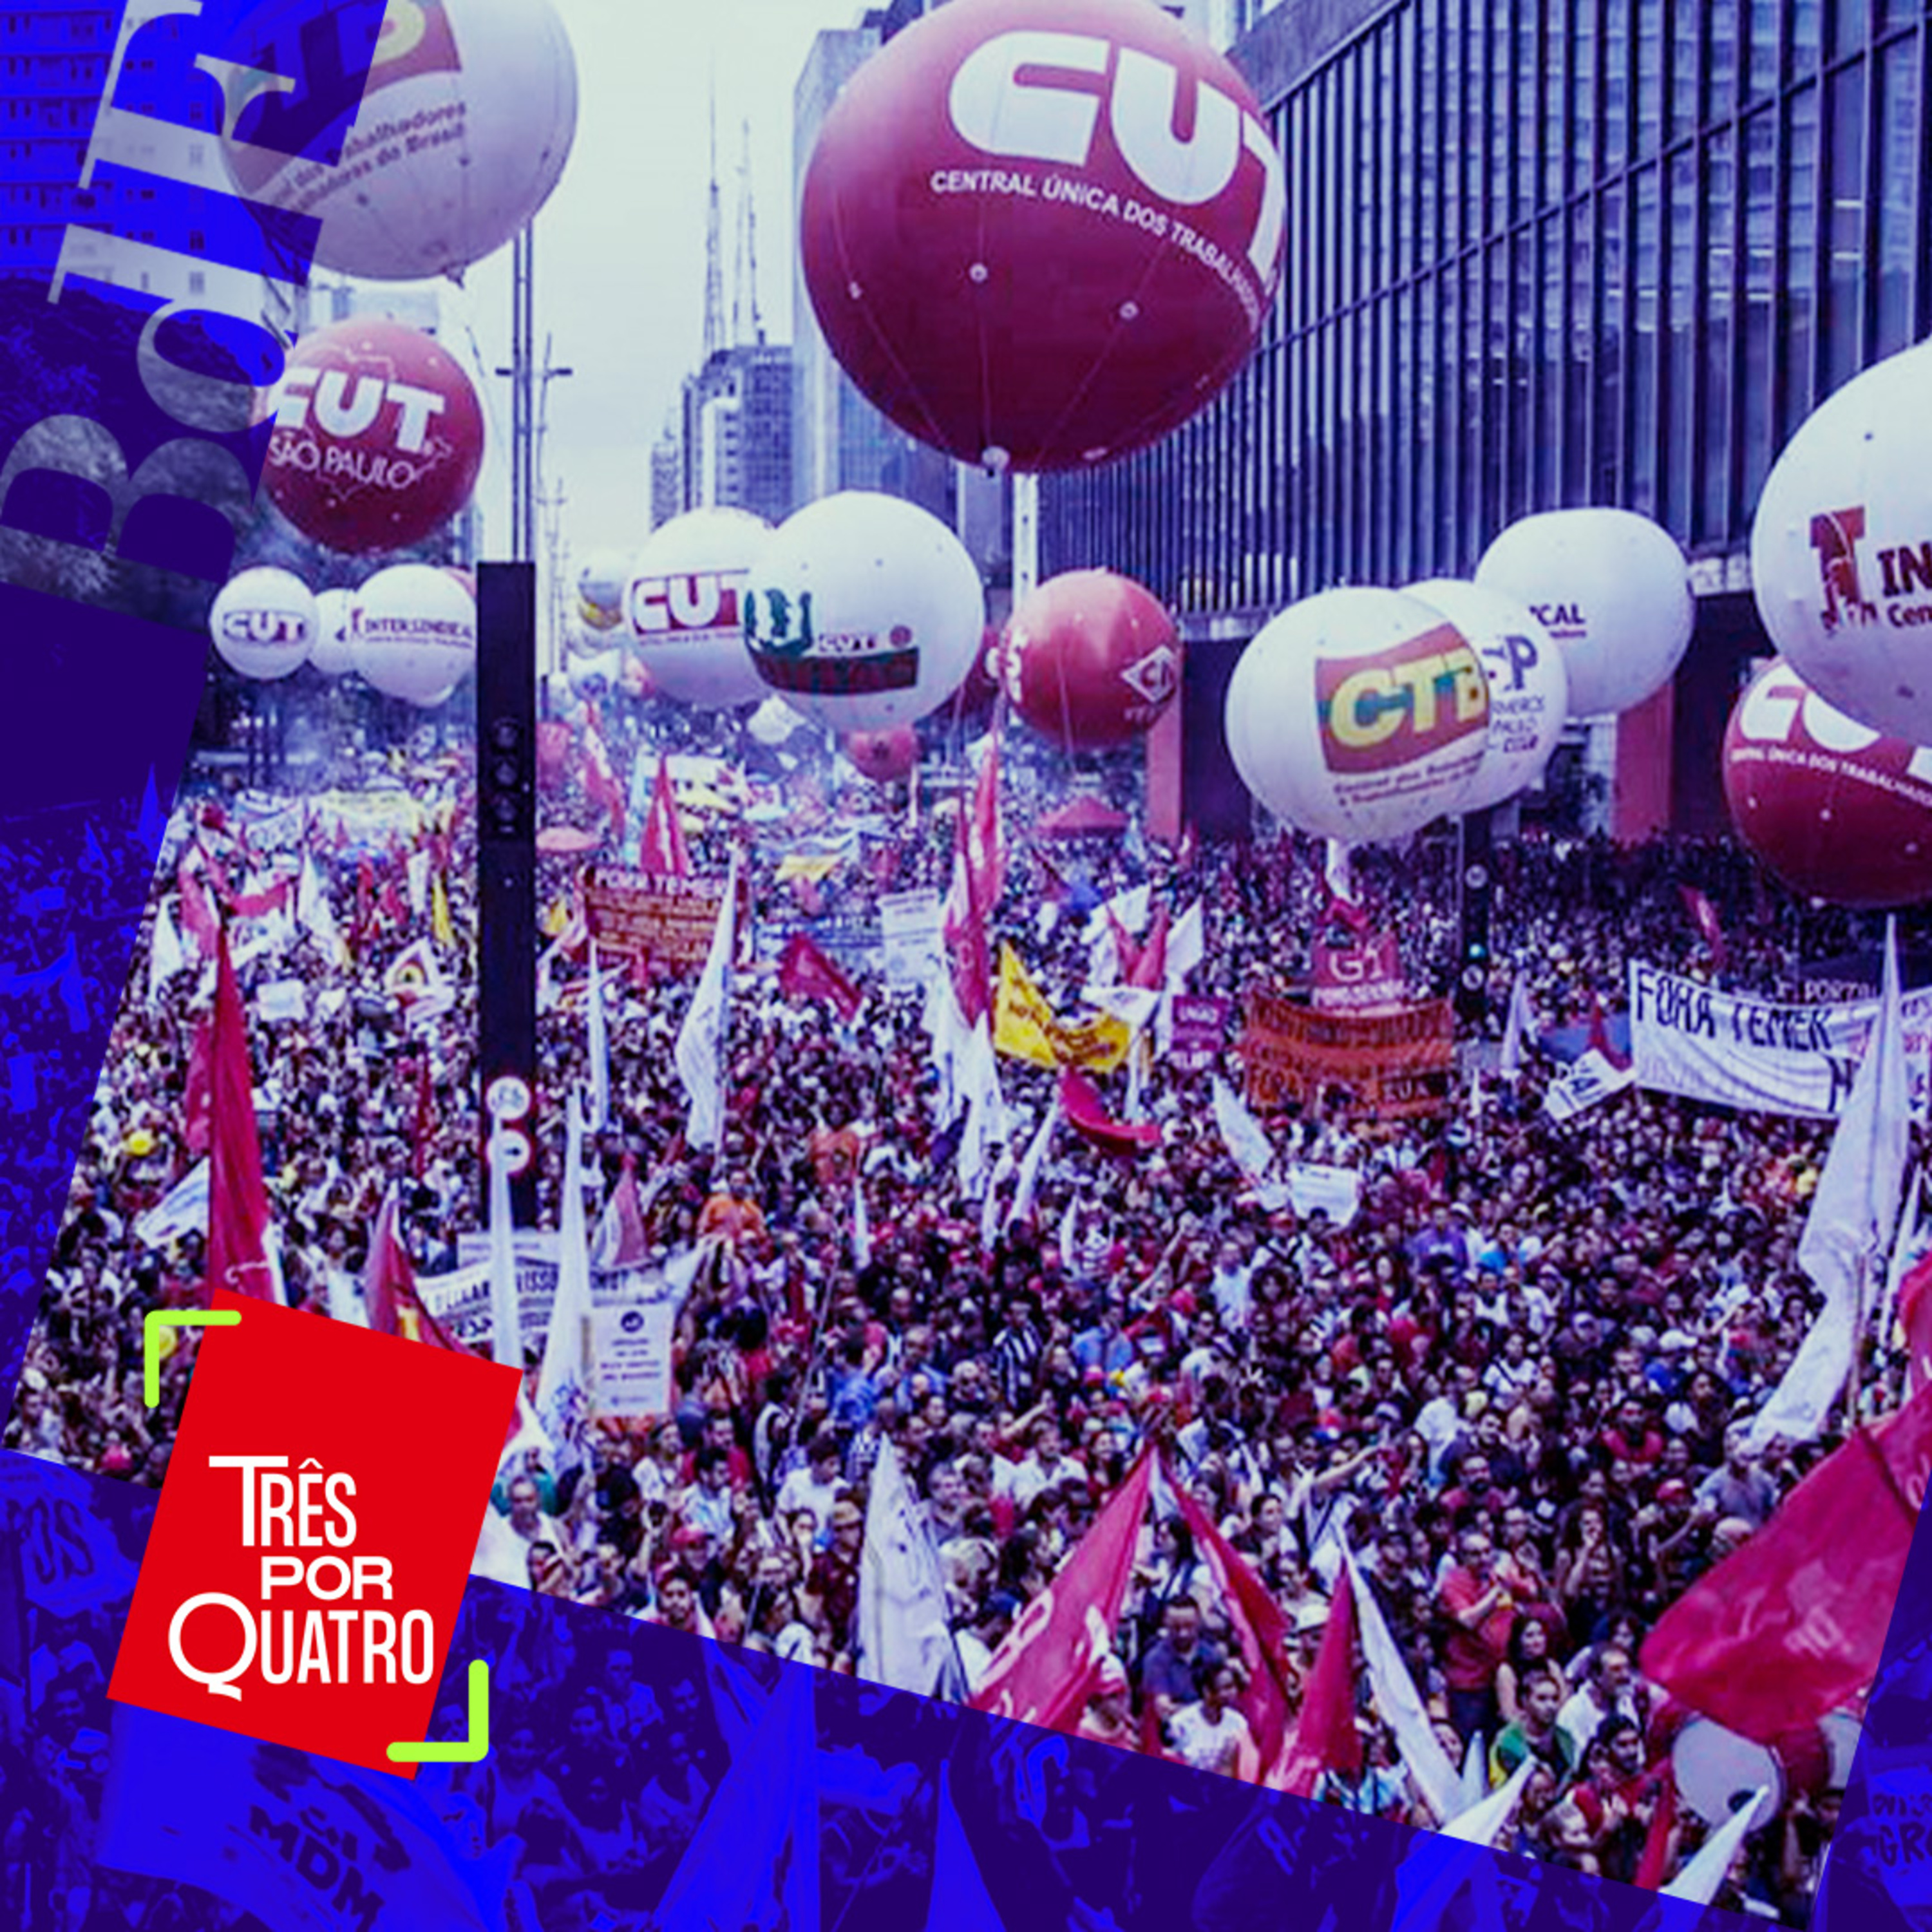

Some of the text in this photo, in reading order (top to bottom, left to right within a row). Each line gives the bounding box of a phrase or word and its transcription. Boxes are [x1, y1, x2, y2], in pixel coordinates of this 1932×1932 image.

[949, 30, 1285, 286] CUT
[931, 170, 1037, 196] CENTRAL
[1041, 174, 1121, 218] ÚNICA
[1122, 200, 1167, 238] DOS
[267, 367, 446, 453] CUT
[323, 444, 415, 490] PAULO
[223, 609, 306, 643] CUT
[1530, 603, 1586, 626] CAL
[1636, 968, 1716, 1038] FORA
